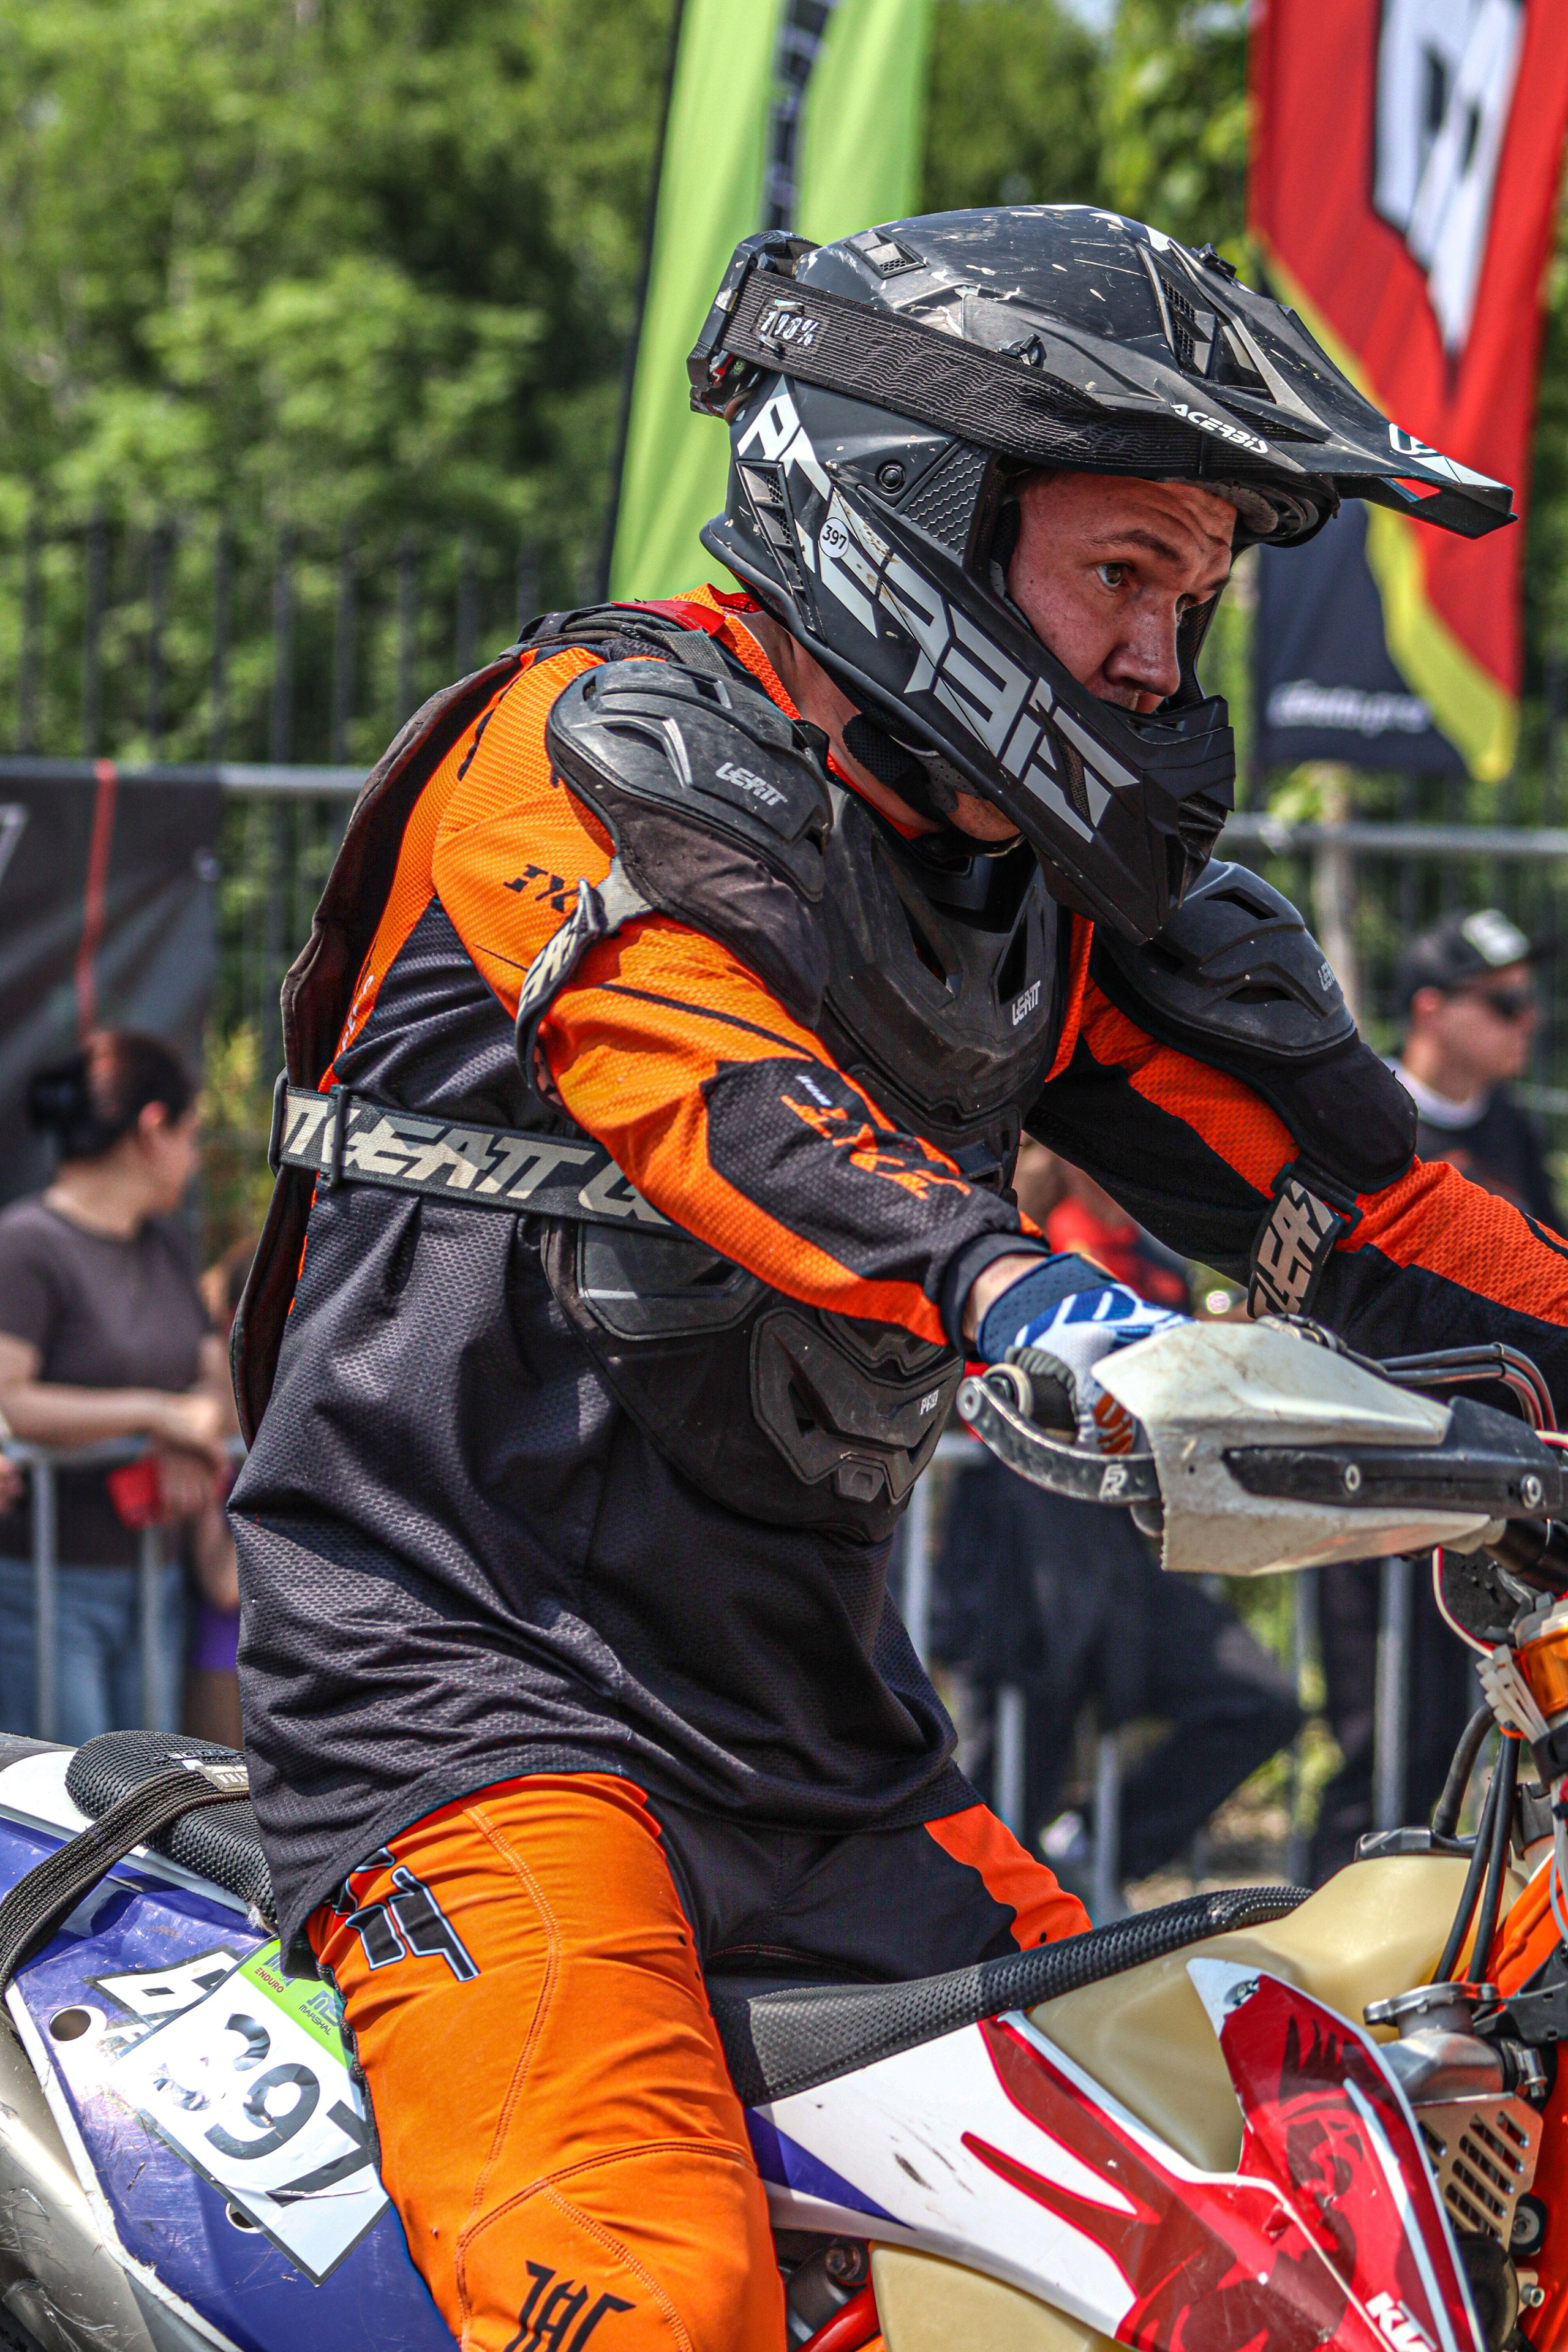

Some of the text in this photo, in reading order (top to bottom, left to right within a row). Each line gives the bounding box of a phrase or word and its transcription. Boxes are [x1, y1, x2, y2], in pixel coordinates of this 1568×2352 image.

[760, 311, 820, 346] 100%
[1170, 404, 1268, 454] ACERBIS
[821, 524, 847, 550] 397
[715, 761, 788, 806] LEATT
[1012, 980, 1041, 1026] LEATT
[254, 1967, 284, 1993] ENDURO
[298, 2004, 332, 2036] MARSHAL
